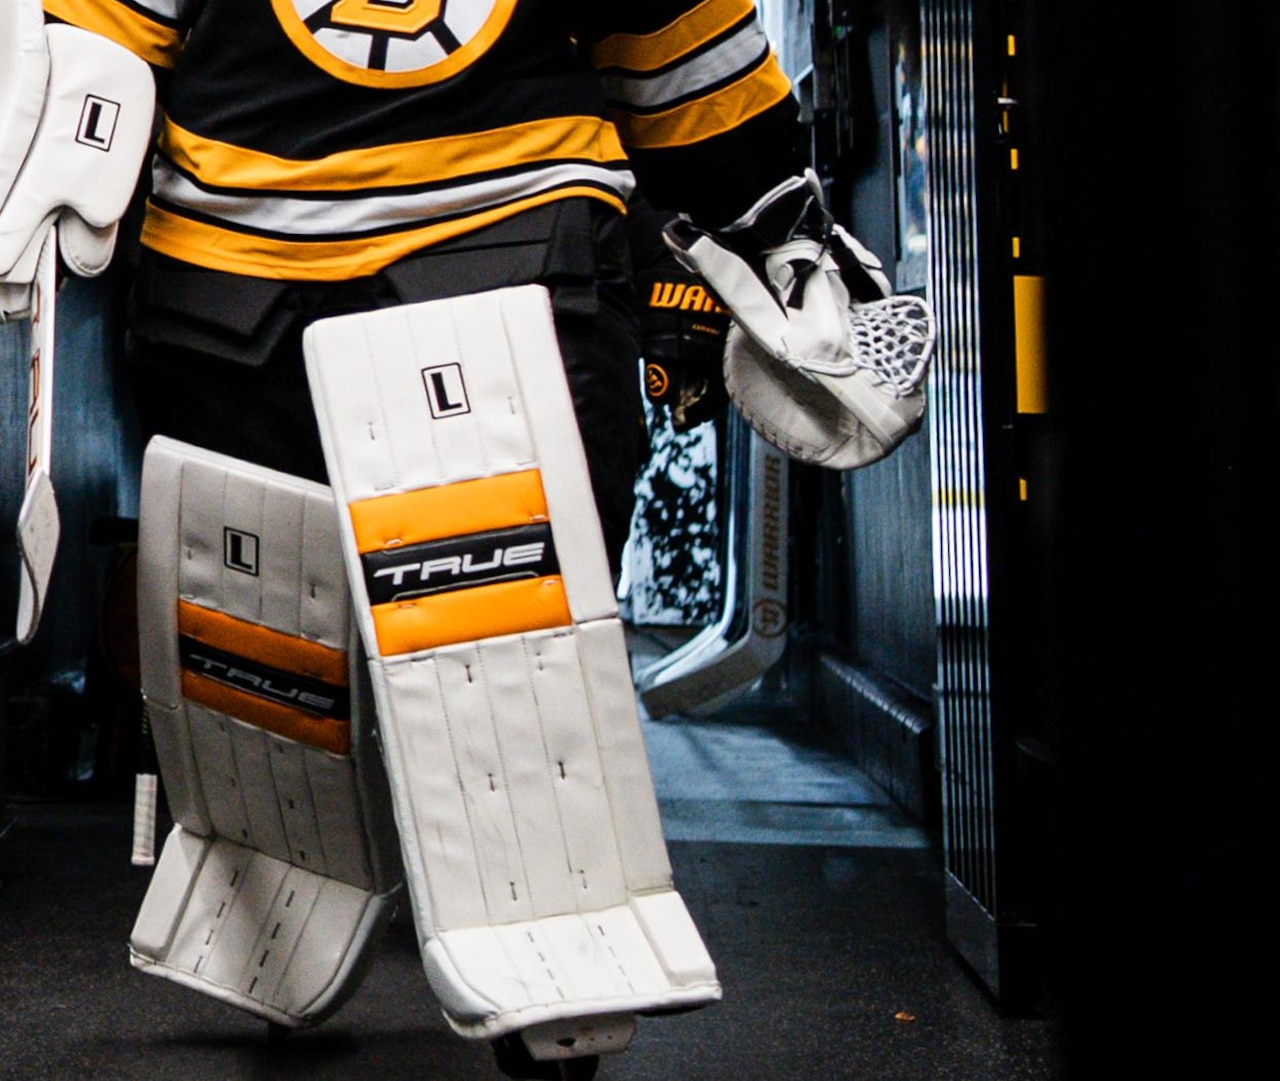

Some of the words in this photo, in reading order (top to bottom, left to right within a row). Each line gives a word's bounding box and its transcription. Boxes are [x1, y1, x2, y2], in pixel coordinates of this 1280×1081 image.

[85, 102, 106, 144] L
[430, 371, 463, 412] L
[231, 533, 253, 570] L
[374, 542, 546, 586] TRUE
[189, 653, 336, 710] TRUE
